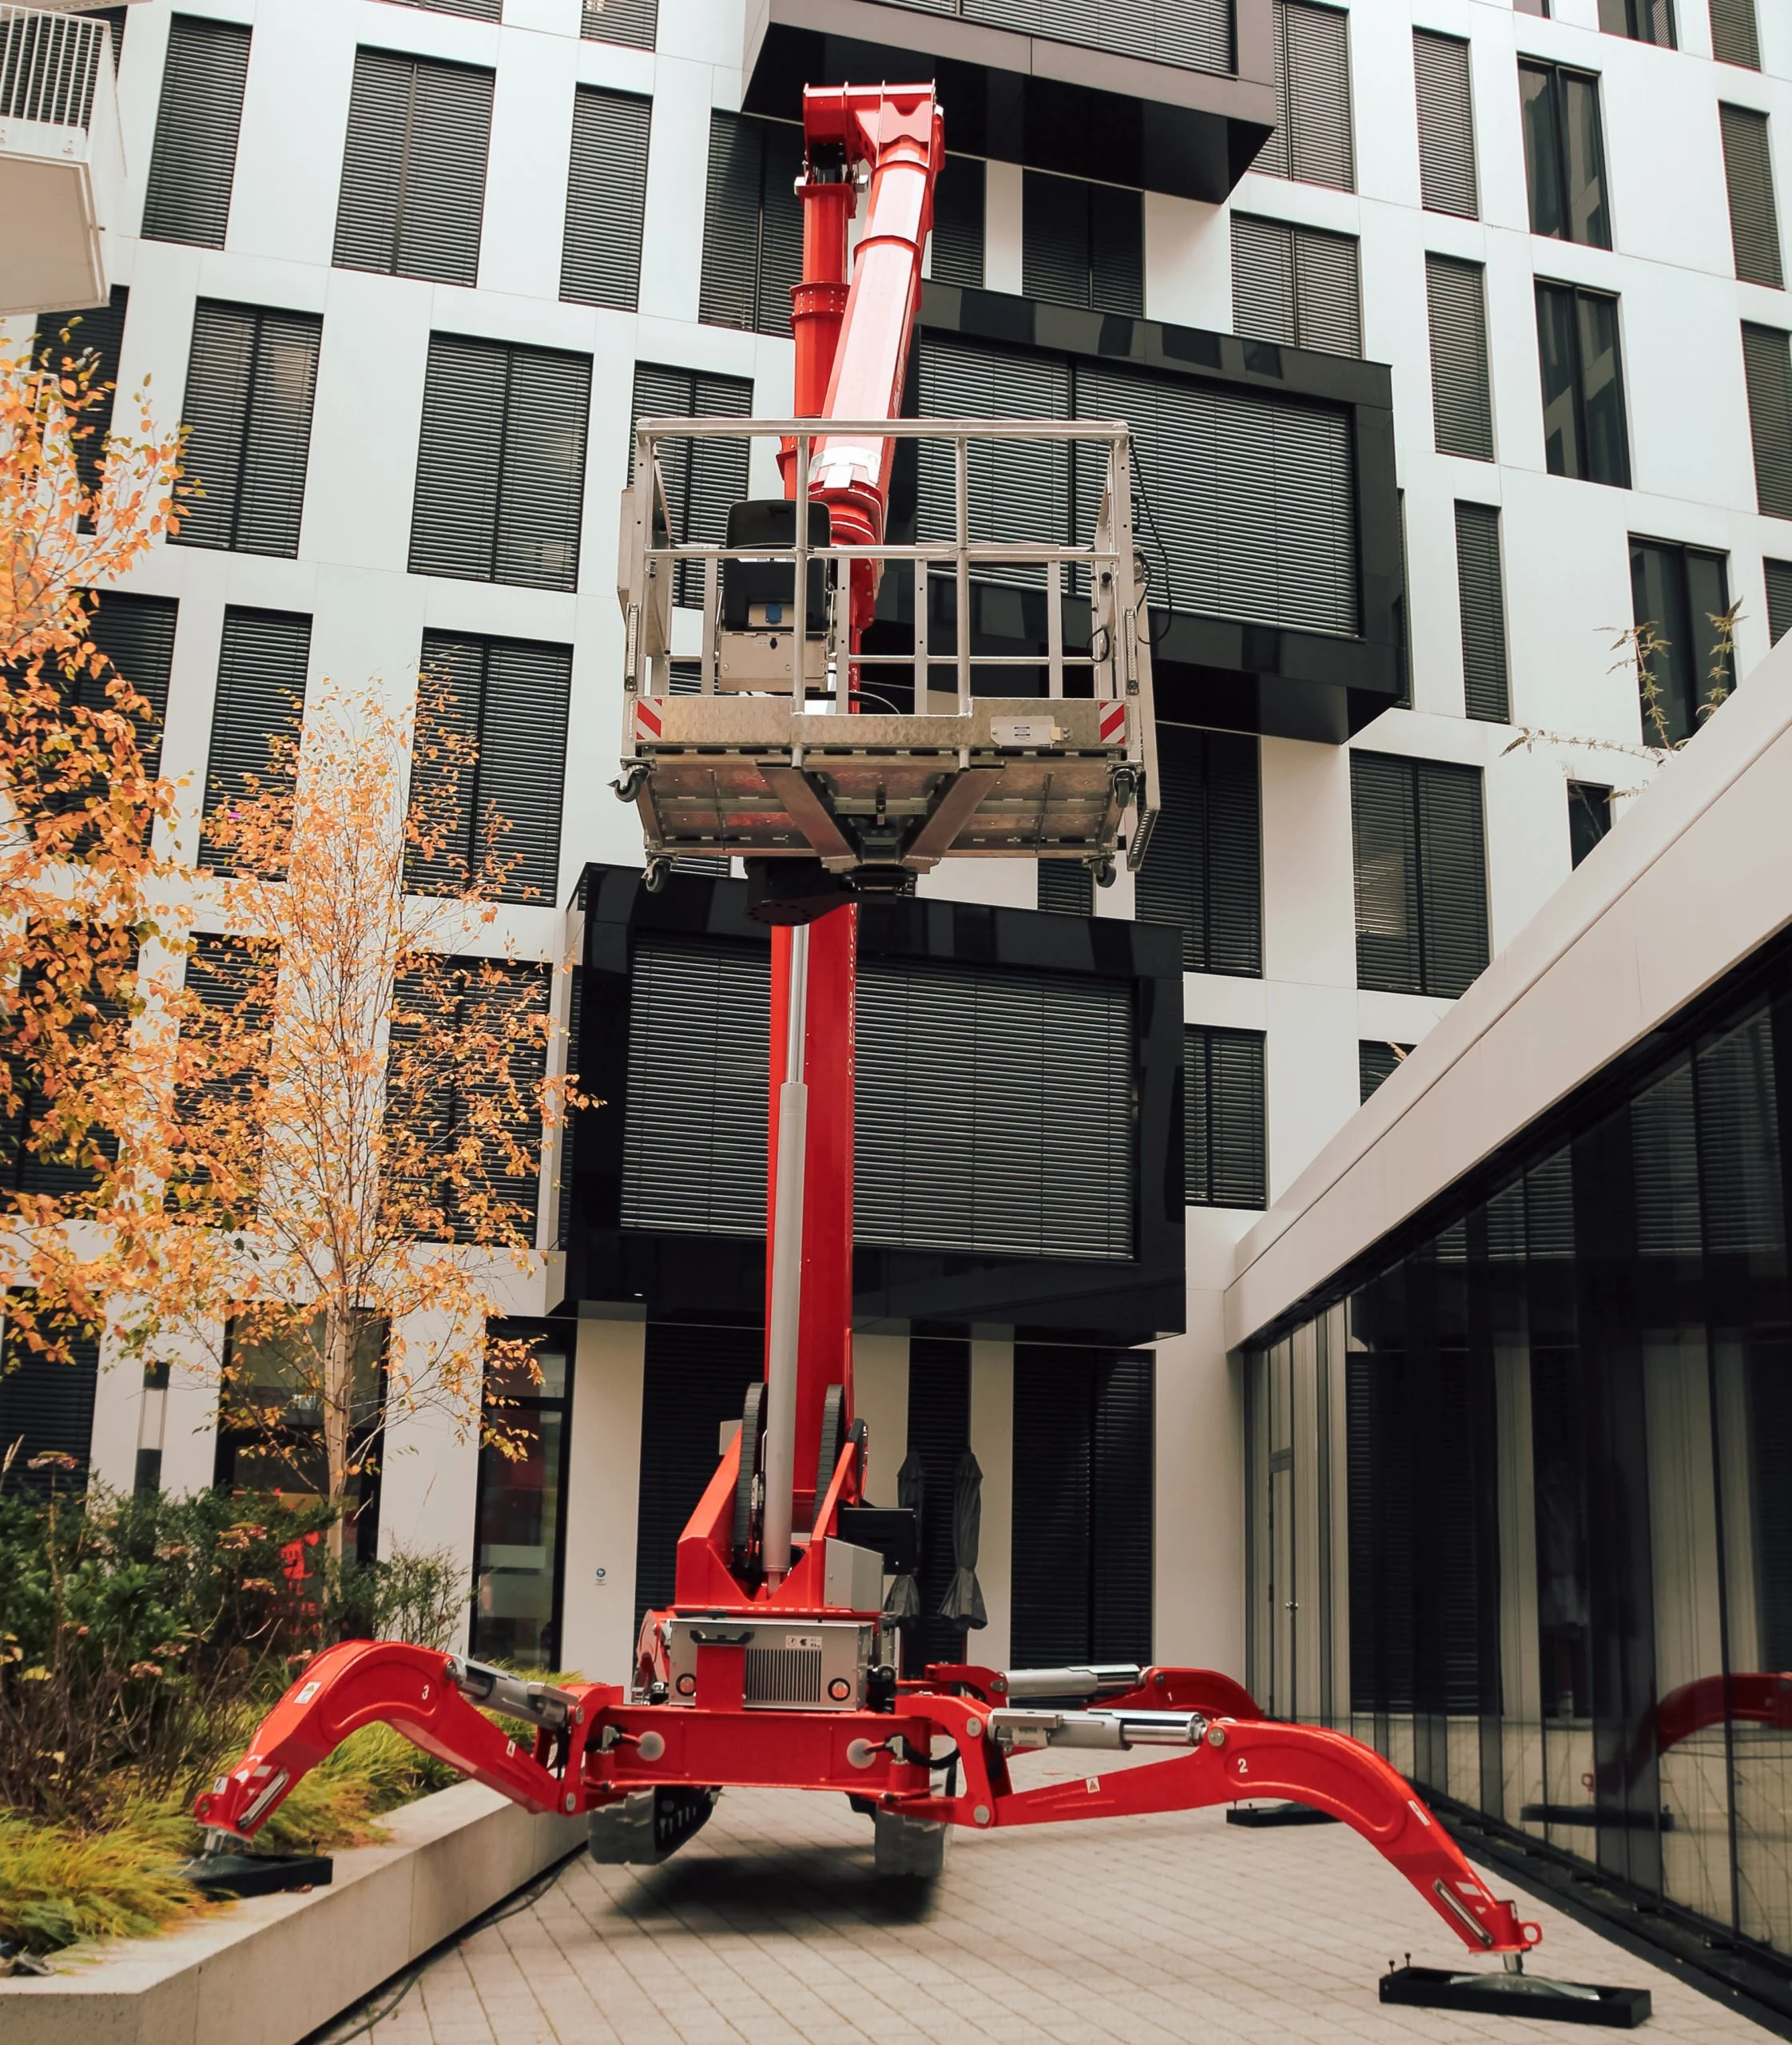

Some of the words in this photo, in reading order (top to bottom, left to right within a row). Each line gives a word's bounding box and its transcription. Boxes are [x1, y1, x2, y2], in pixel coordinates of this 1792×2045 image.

[422, 1684, 430, 1701] 3
[1167, 1691, 1173, 1702] 1
[1238, 1757, 1248, 1773] 2
